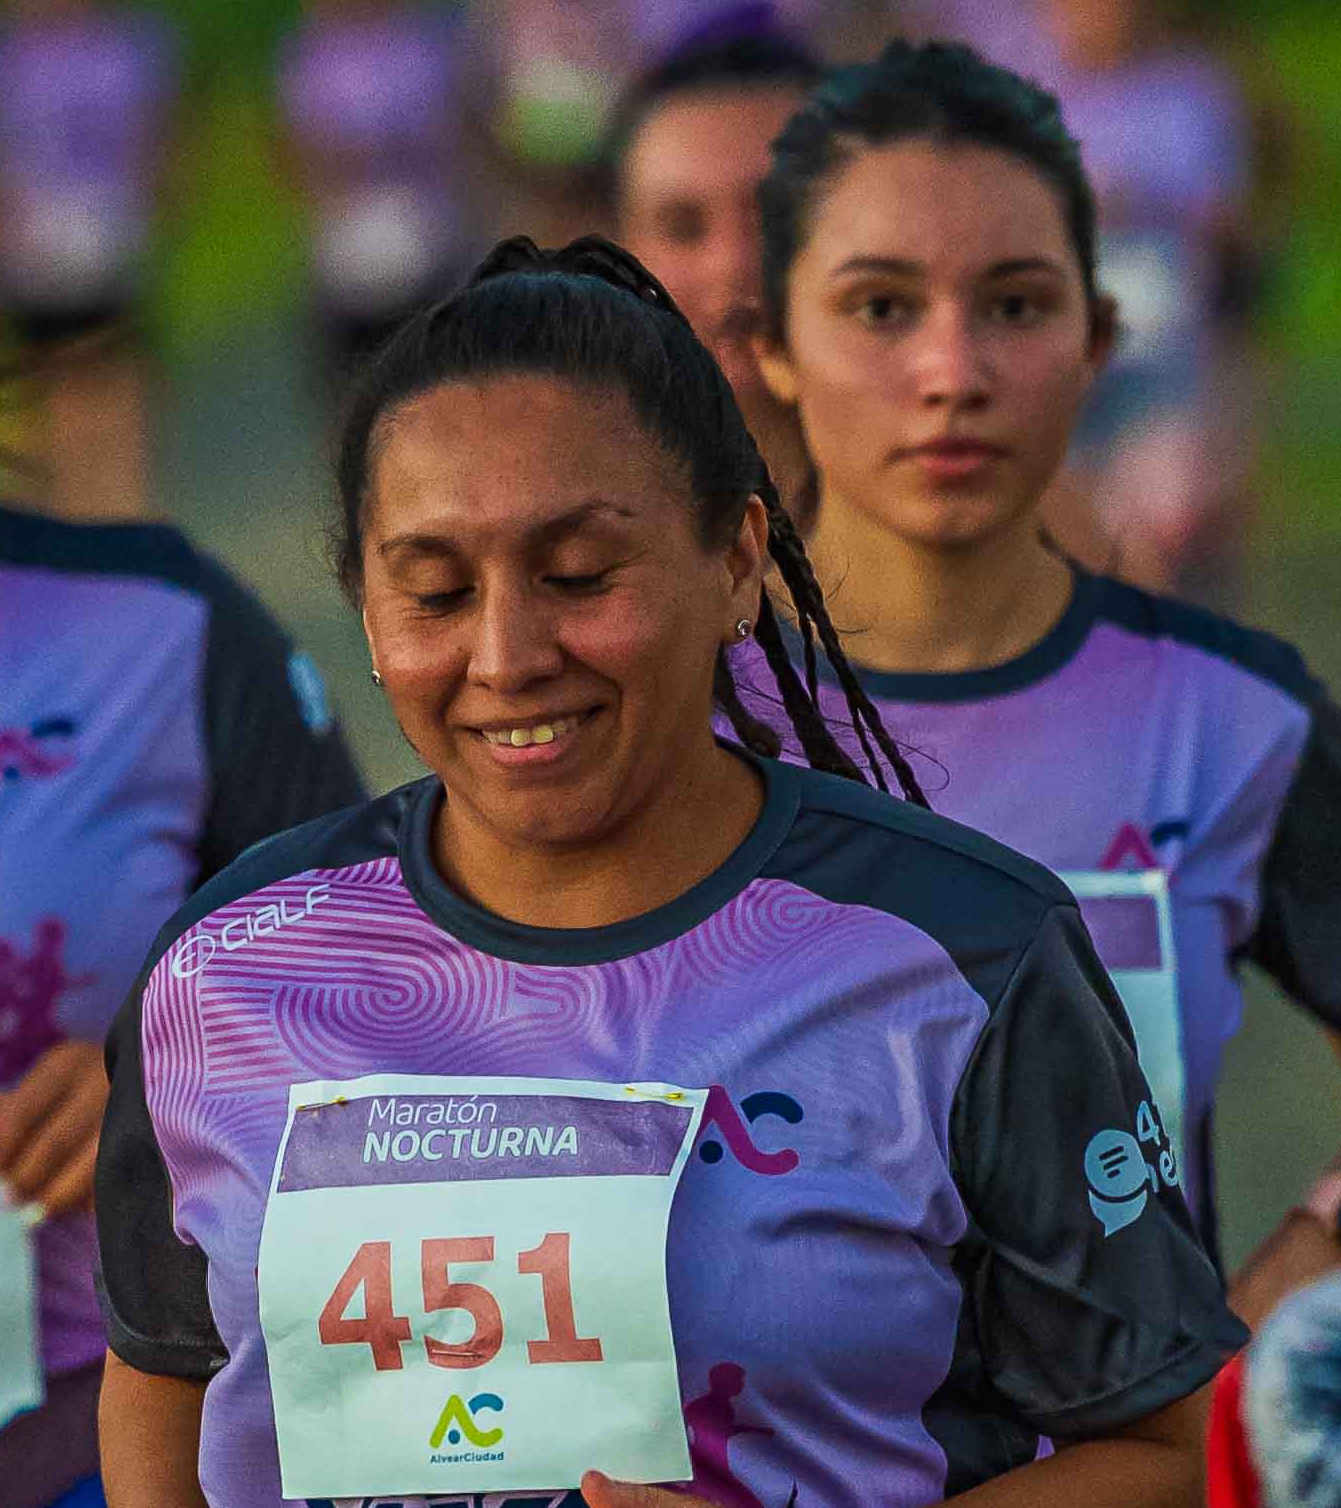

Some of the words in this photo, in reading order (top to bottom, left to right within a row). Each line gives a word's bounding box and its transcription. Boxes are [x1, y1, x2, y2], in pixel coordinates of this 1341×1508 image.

[367, 1095, 498, 1126] Maratón
[363, 1125, 579, 1164] NOCTURNA
[318, 1232, 604, 1371] 451
[430, 1451, 505, 1464] AlvearCiudad
